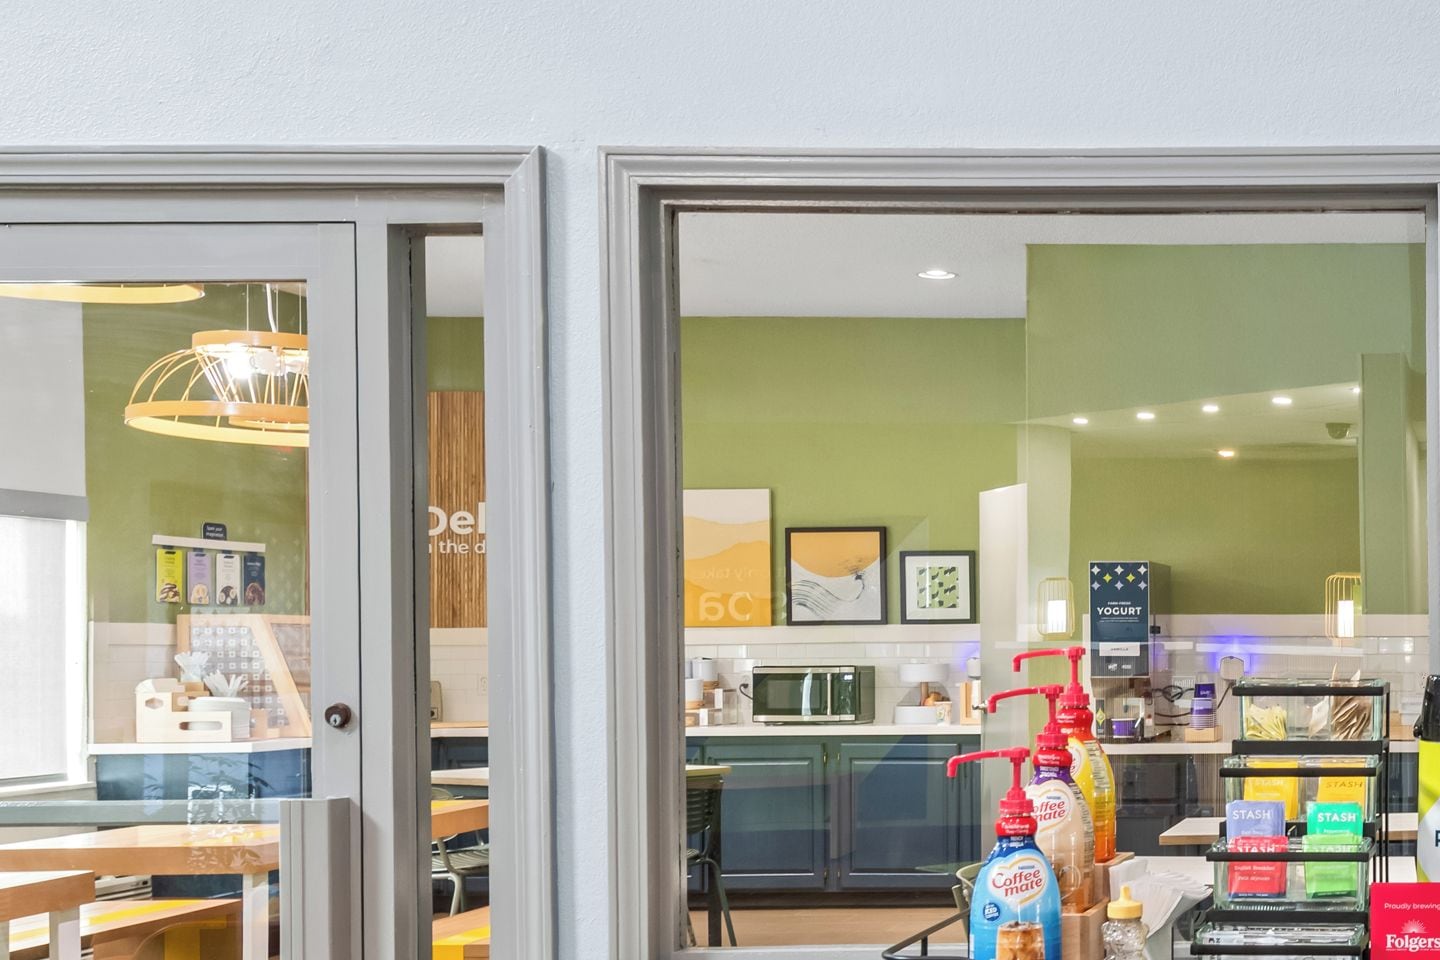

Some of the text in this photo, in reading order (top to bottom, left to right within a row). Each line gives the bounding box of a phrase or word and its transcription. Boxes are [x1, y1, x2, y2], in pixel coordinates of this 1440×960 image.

[439, 539, 469, 554] the
[1096, 607, 1142, 616] YOGURT
[1325, 781, 1363, 789] STASH
[1034, 801, 1065, 814] offee
[1232, 810, 1271, 820] STASH
[1317, 812, 1357, 823] STASH
[992, 869, 1041, 889] Coffee
[1004, 878, 1043, 897] mate
[1384, 902, 1411, 910] Proudly
